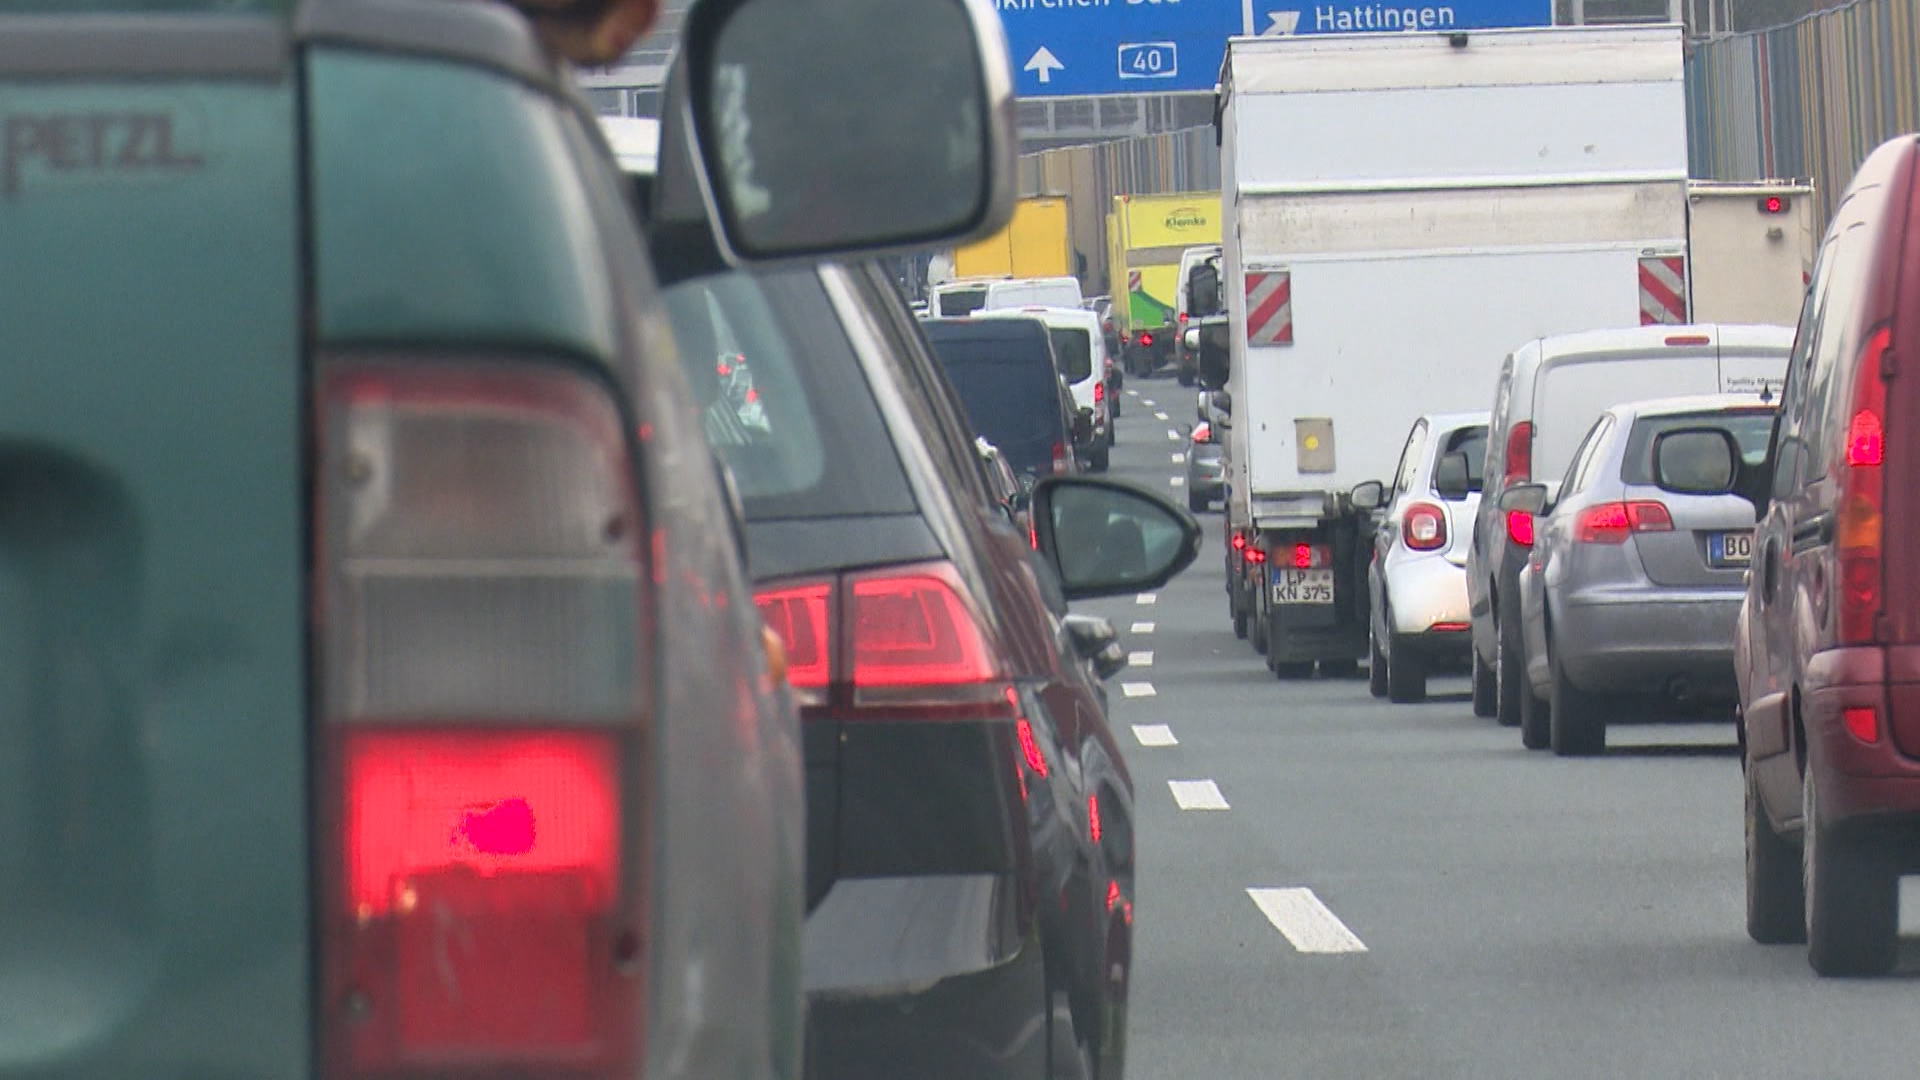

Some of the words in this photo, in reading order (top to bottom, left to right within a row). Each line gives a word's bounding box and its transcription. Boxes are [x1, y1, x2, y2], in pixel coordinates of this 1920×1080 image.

[1315, 3, 1454, 32] Hattingen
[1132, 49, 1162, 71] 40
[6, 113, 205, 194] PETZL
[1725, 536, 1750, 556] BO
[1276, 586, 1297, 600] KN
[1302, 586, 1331, 600] 375
